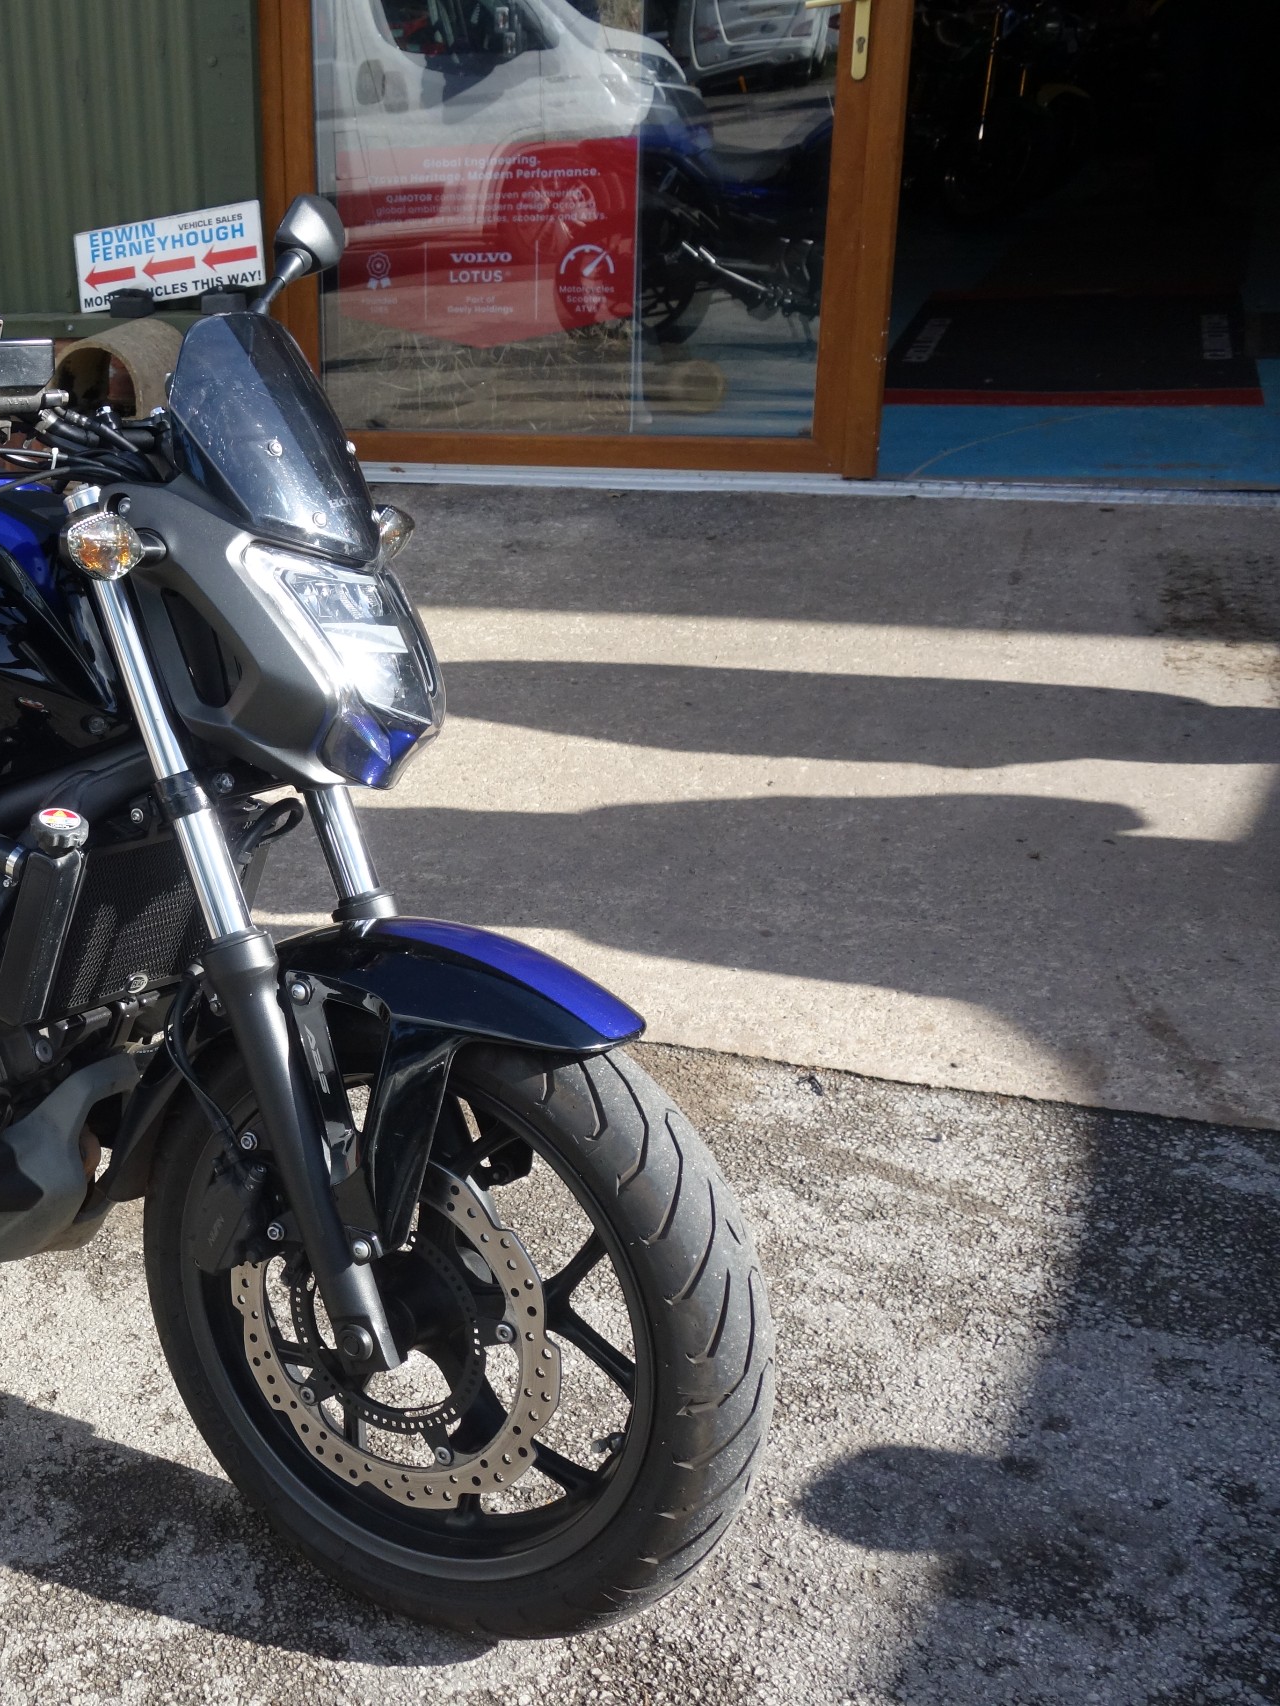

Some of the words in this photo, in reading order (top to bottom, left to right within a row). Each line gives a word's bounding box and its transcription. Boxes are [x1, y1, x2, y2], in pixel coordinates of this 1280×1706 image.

[423, 157, 461, 168] Global
[516, 166, 601, 179] Performance.
[386, 193, 433, 203] QJMOTOR
[178, 219, 213, 231] VEHICLE
[215, 213, 243, 224] SALES
[89, 222, 156, 248] EDWIN
[91, 223, 245, 263] FERNEYHOUGH
[450, 251, 513, 263] VOLVO
[192, 276, 224, 291] THIS
[227, 270, 262, 285] WAY!
[449, 270, 503, 283] LOTUS
[559, 285, 615, 294] Motorcycles
[303, 1023, 331, 1095] ABS
